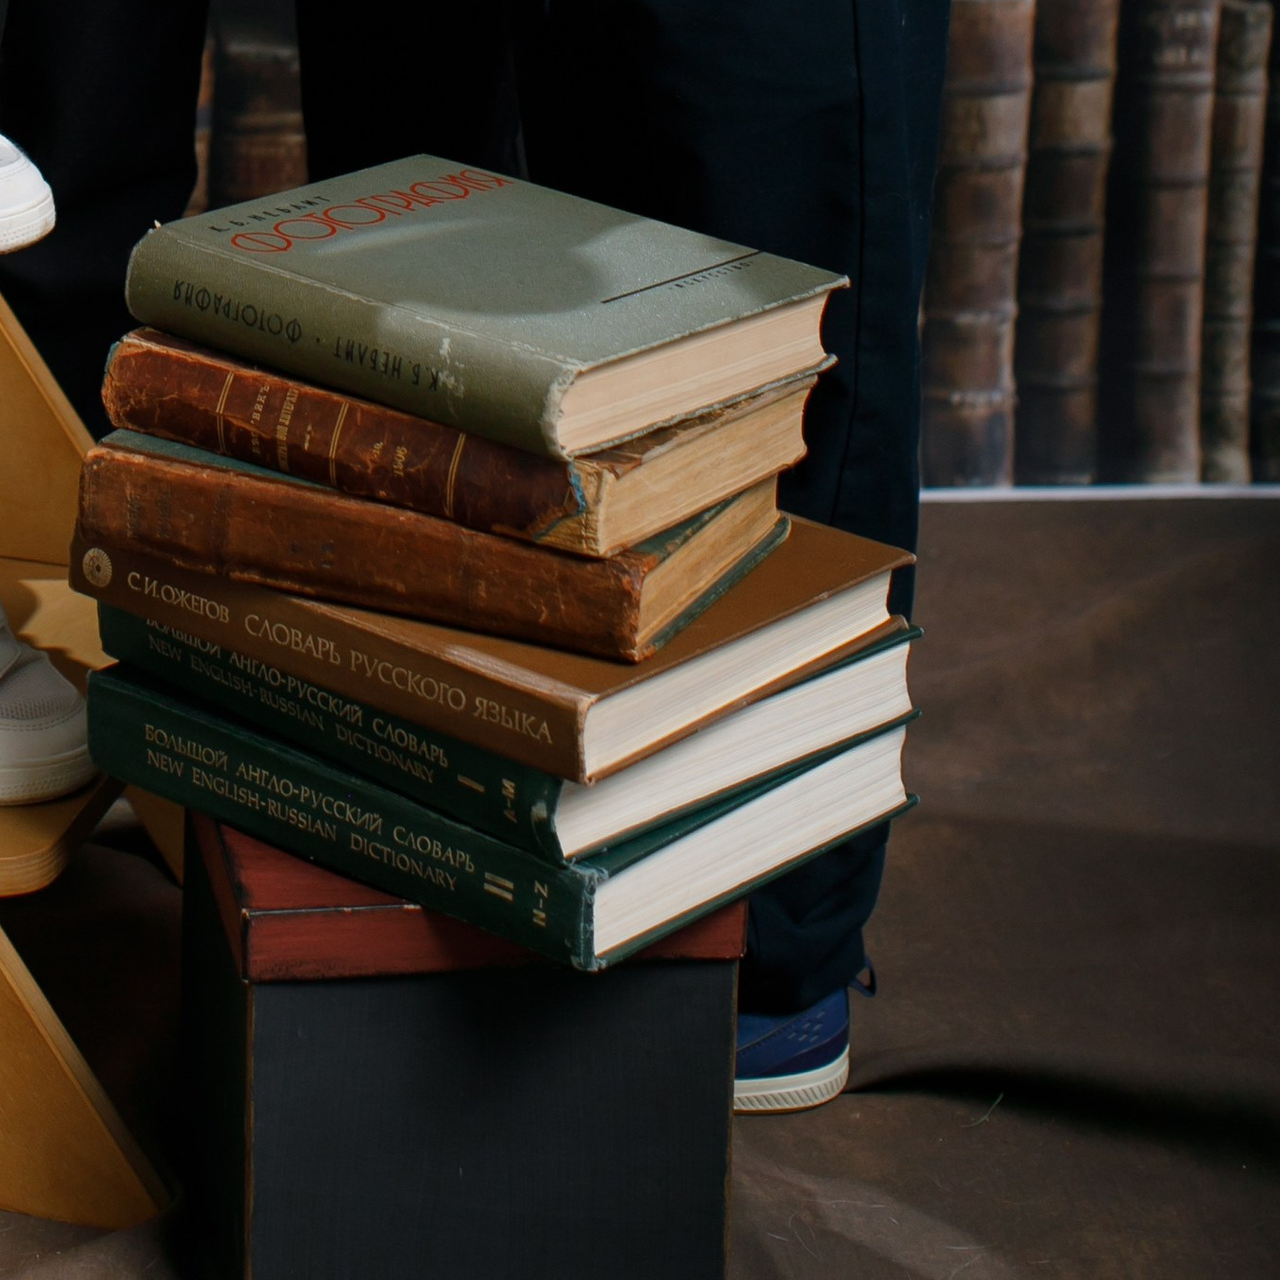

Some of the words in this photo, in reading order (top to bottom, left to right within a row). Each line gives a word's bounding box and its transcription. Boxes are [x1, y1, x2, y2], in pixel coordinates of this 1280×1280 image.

[230, 169, 514, 253] ФОТОГРАФИЯ
[173, 279, 302, 344] ФОТОГРАФИЯ
[333, 335, 402, 379] НЕБЛИТ
[149, 634, 182, 662] NEW
[190, 655, 325, 731] ENGLISH-RUSSIAN
[336, 723, 435, 784] DICTIONARY
[228, 651, 364, 727] АНГЛО-РУССКИЙ
[372, 717, 448, 768] СЛОВАРЬ
[244, 614, 341, 665] СЛОВАРЬ
[350, 649, 467, 711] РУССКОГО
[472, 697, 553, 744] ЯЗЫКА
[145, 723, 229, 771] БОЛЬШОЙ
[235, 761, 383, 835] АНГЛО-РУССКИЙ
[393, 825, 475, 873] СЛОВАРЬ
[146, 748, 184, 777] NEW
[192, 766, 337, 841] ENGLISH-RUSSIAN
[349, 832, 457, 892] DICTIONARY
